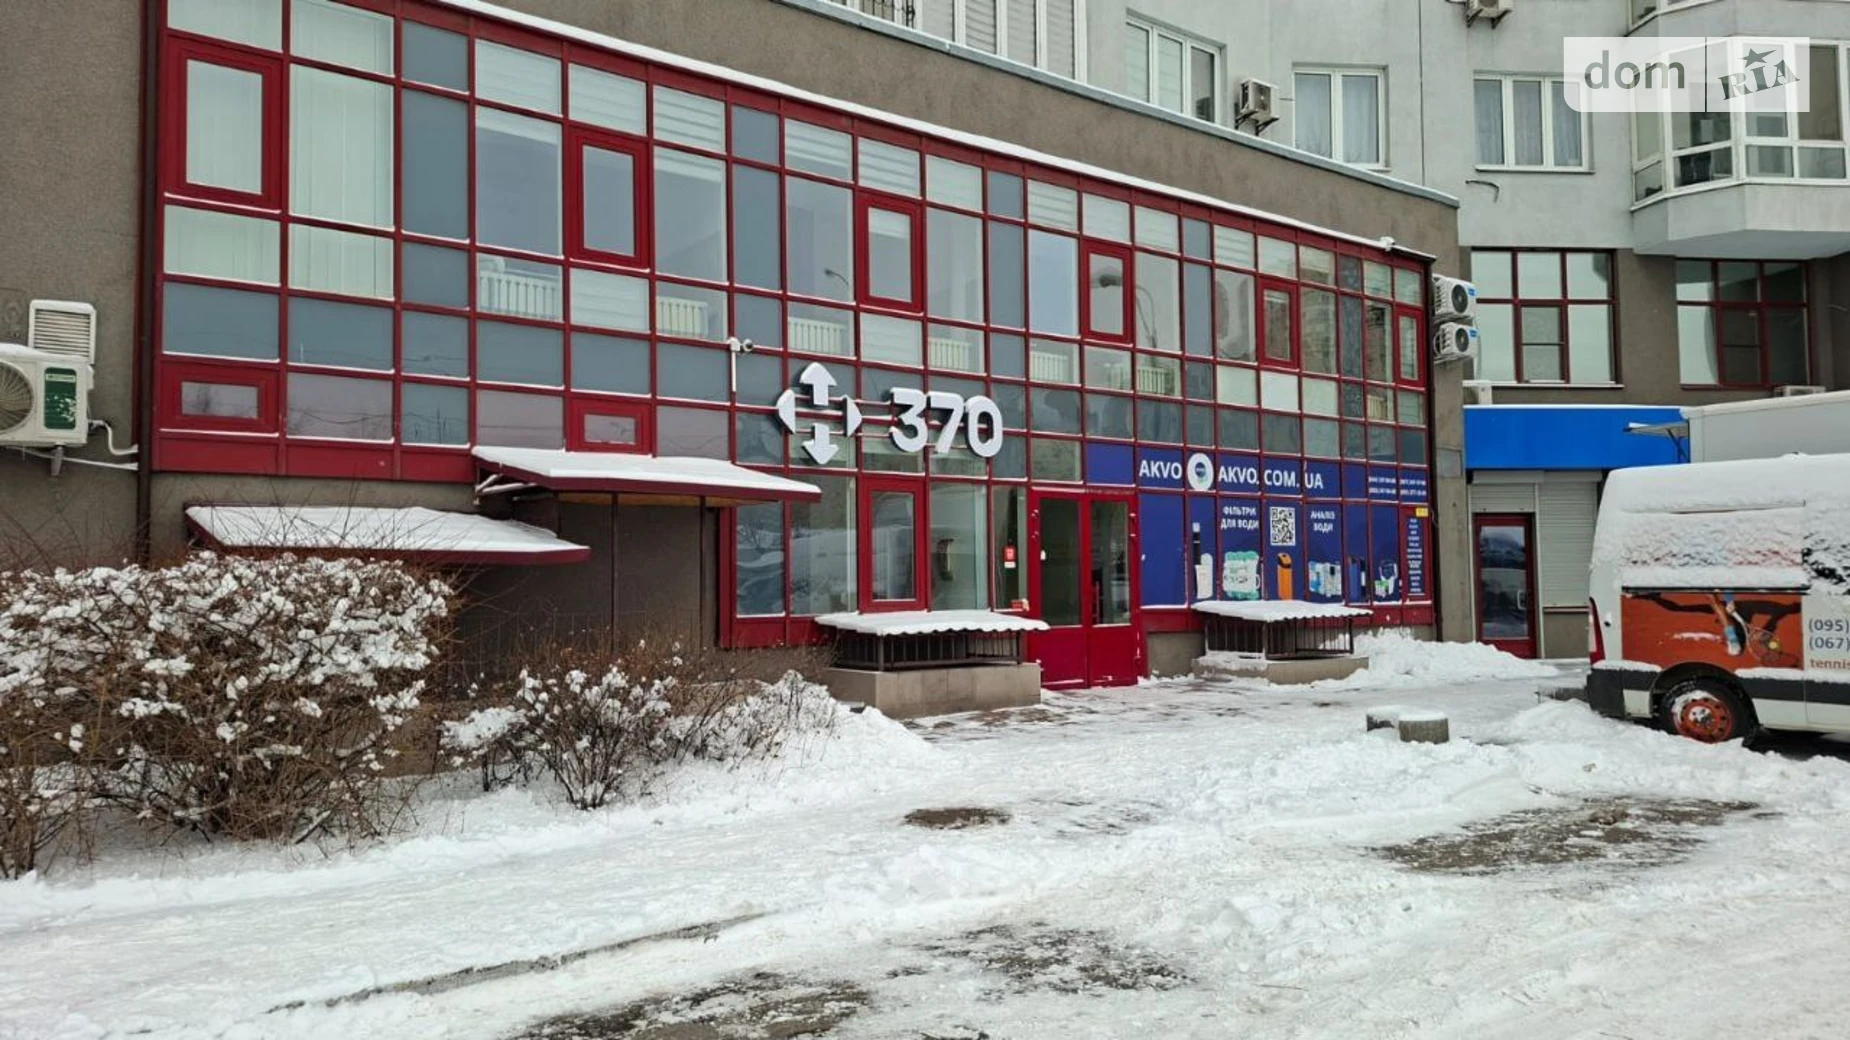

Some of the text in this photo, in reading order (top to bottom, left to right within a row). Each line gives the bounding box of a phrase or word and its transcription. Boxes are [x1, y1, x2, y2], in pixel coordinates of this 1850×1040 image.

[890, 387, 1003, 457] 370
[1139, 459, 1182, 480] AKVO
[1223, 506, 1257, 517] ФІЛЬТРИ
[1310, 510, 1336, 520] АНАЛІЗ
[1220, 518, 1259, 530] ДЛЯ ВОДИ
[1313, 523, 1334, 533] ВОДИ
[1809, 618, 1849, 633] (095)
